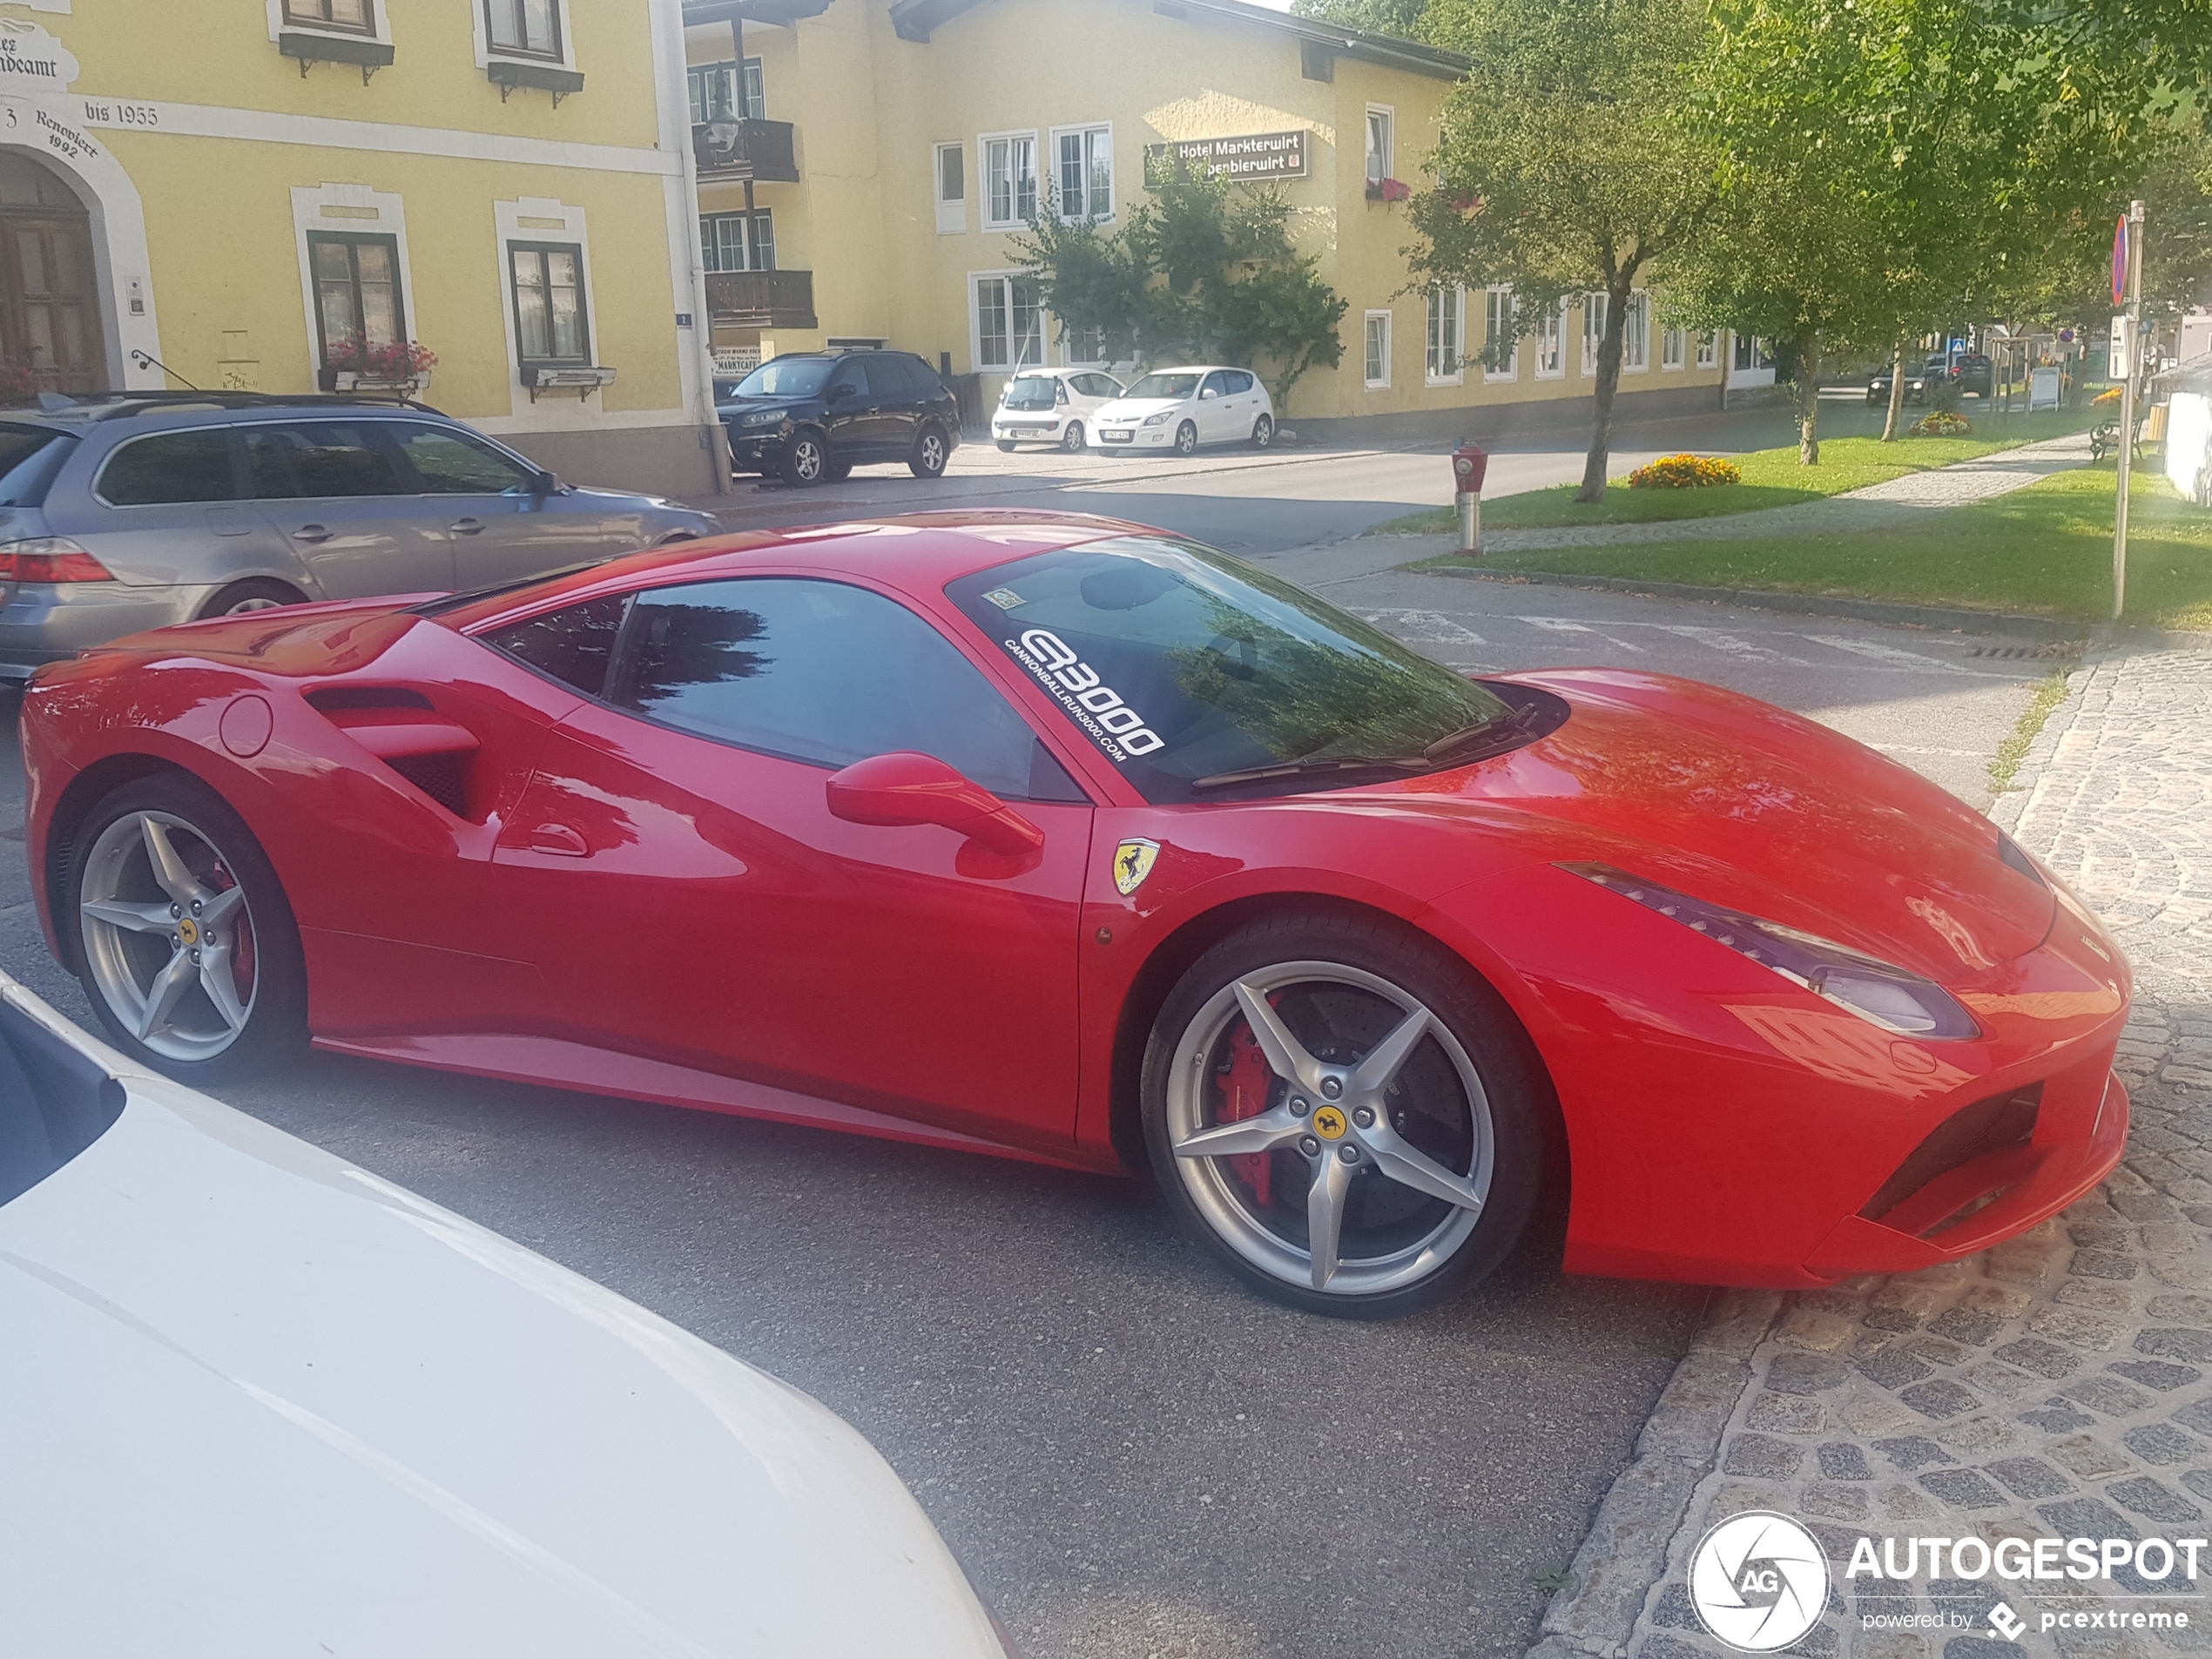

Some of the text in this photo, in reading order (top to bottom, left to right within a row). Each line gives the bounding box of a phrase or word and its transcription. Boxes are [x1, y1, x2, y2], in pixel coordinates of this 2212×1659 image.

[84, 101, 158, 126] bis 1955
[36, 110, 99, 158] Renoviert
[49, 134, 78, 159] 1992
[1179, 134, 1299, 158] Hotel Markterwirt
[1207, 155, 1285, 178] penbierwirt
[1004, 638, 1127, 763] CANNONBALLRUN3000.COM
